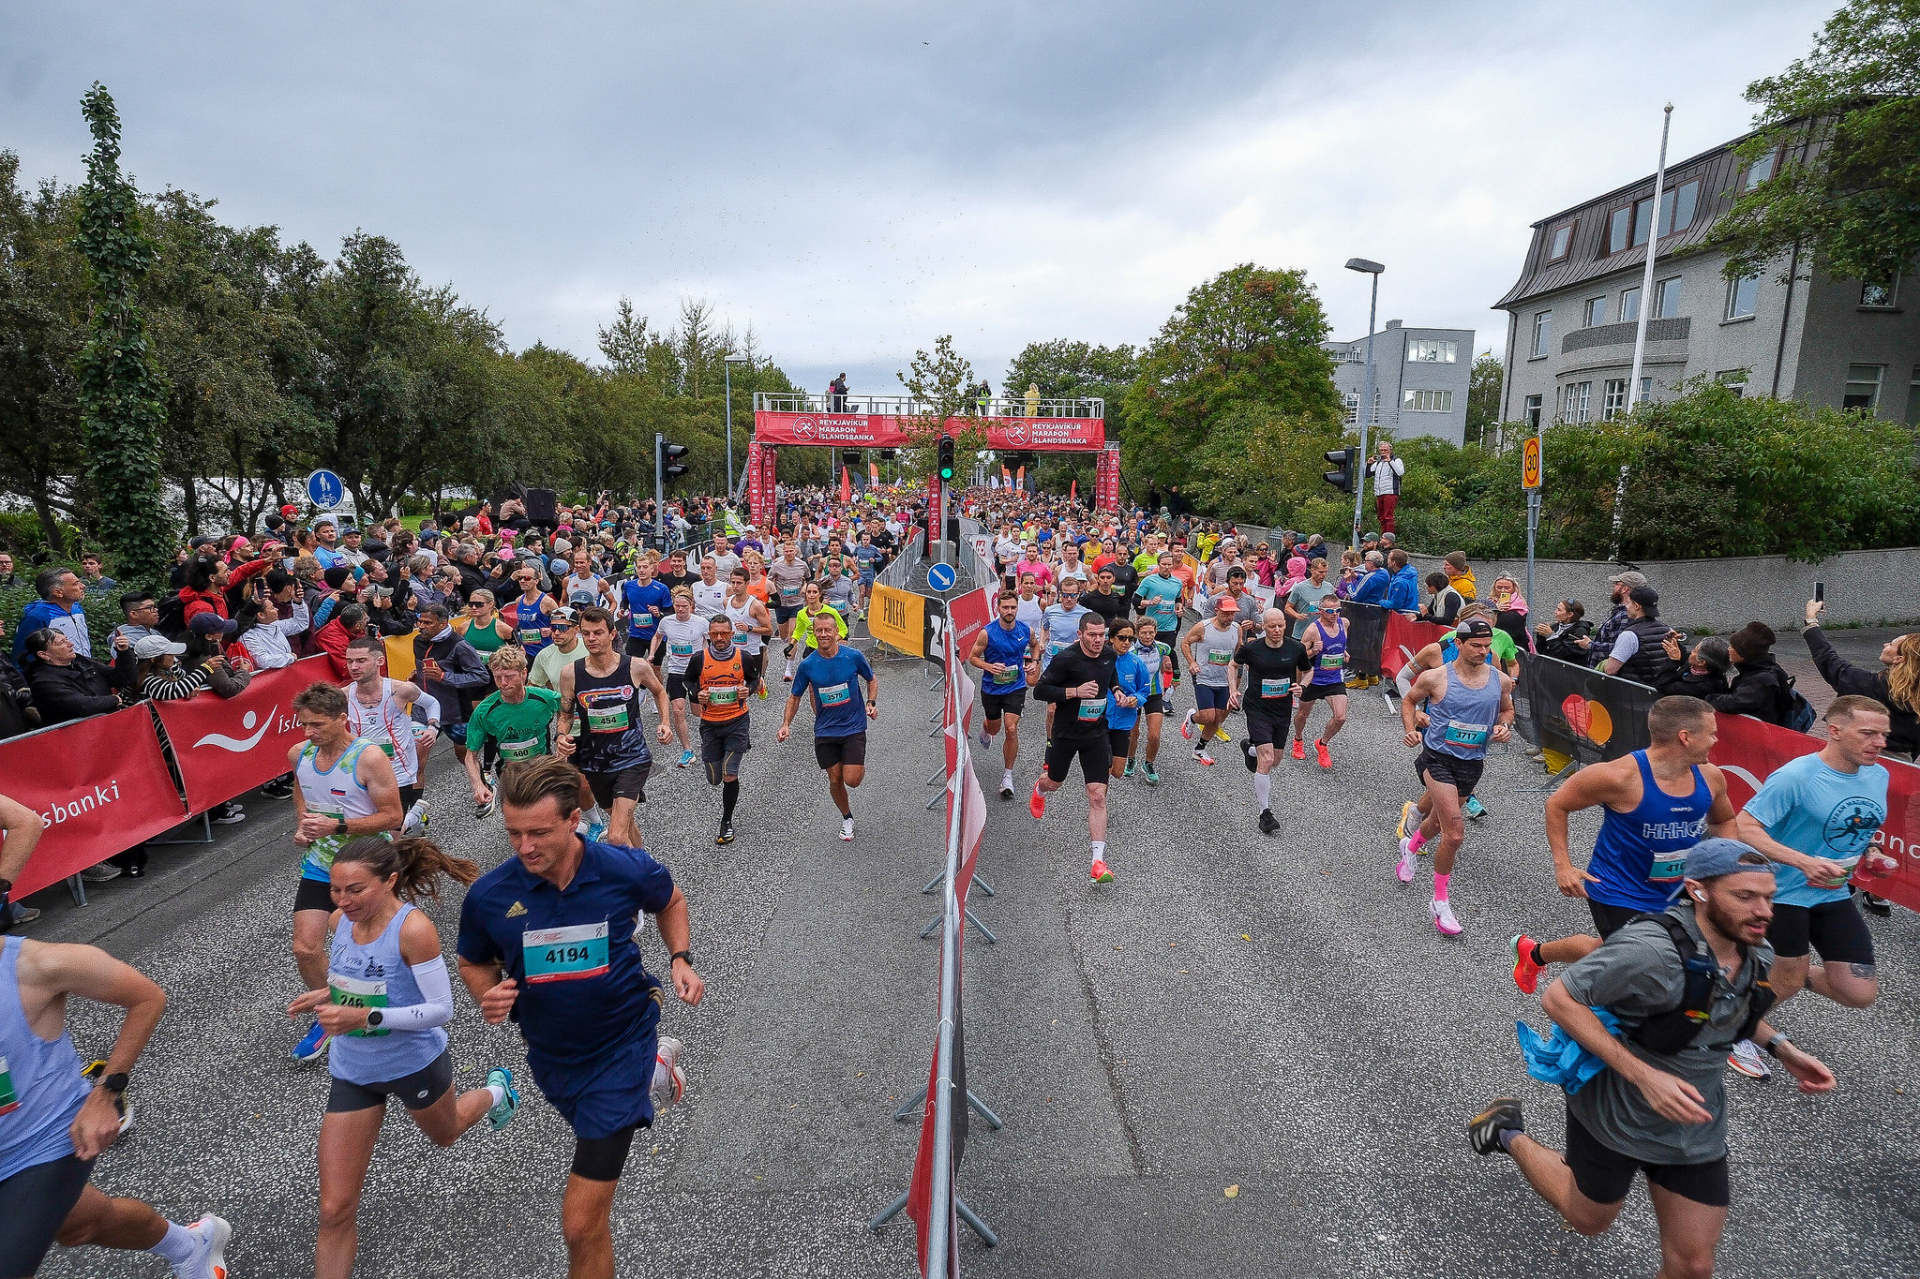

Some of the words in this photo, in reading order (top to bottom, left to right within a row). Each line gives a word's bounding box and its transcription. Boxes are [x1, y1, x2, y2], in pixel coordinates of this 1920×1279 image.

[818, 418, 869, 427] REYKJAVÍKUR
[1032, 422, 1081, 430] REYKJAVÍKUR
[818, 433, 875, 441] ÍSLANDSBANKA
[1031, 436, 1087, 444] ÍSLANDSBANKA
[1527, 453, 1537, 471] 30
[600, 716, 617, 725] 454
[1455, 731, 1477, 740] 3717
[545, 946, 590, 964] 4194
